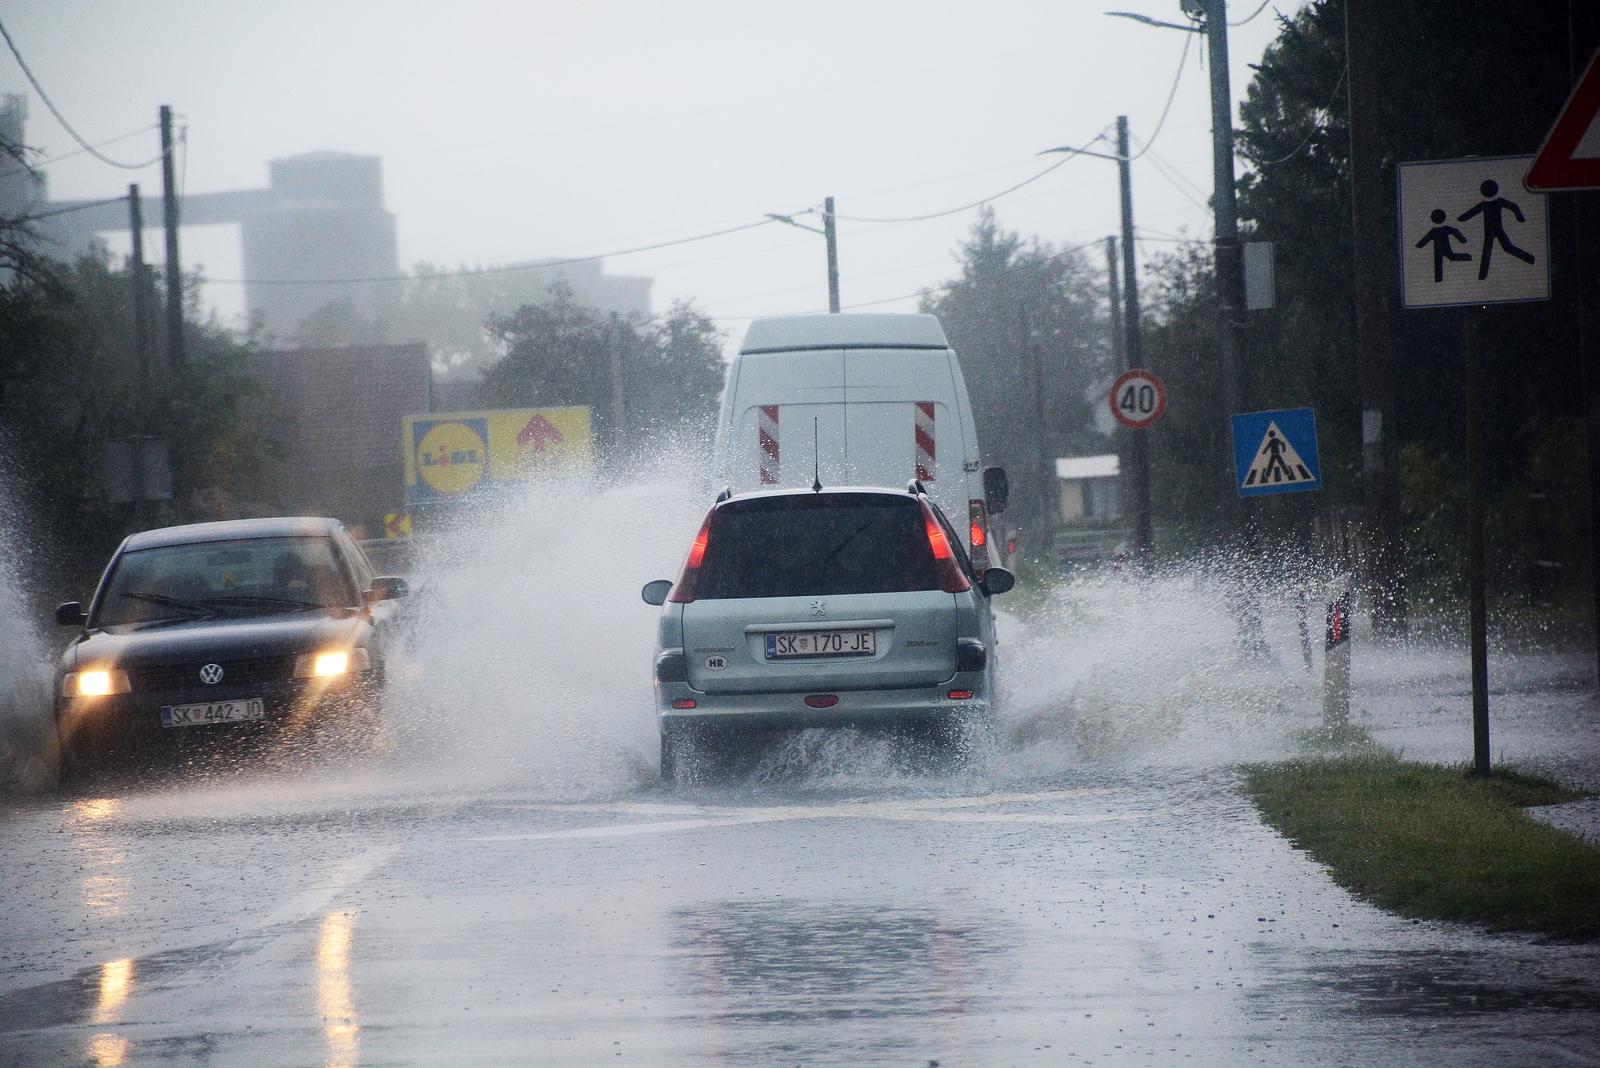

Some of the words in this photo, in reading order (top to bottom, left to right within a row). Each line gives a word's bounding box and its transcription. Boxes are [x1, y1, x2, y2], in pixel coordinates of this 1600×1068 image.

[1120, 385, 1153, 413] 40
[778, 635, 798, 653] SK
[813, 633, 870, 651] 170-JE
[709, 659, 724, 667] HR
[173, 708, 191, 723] SK
